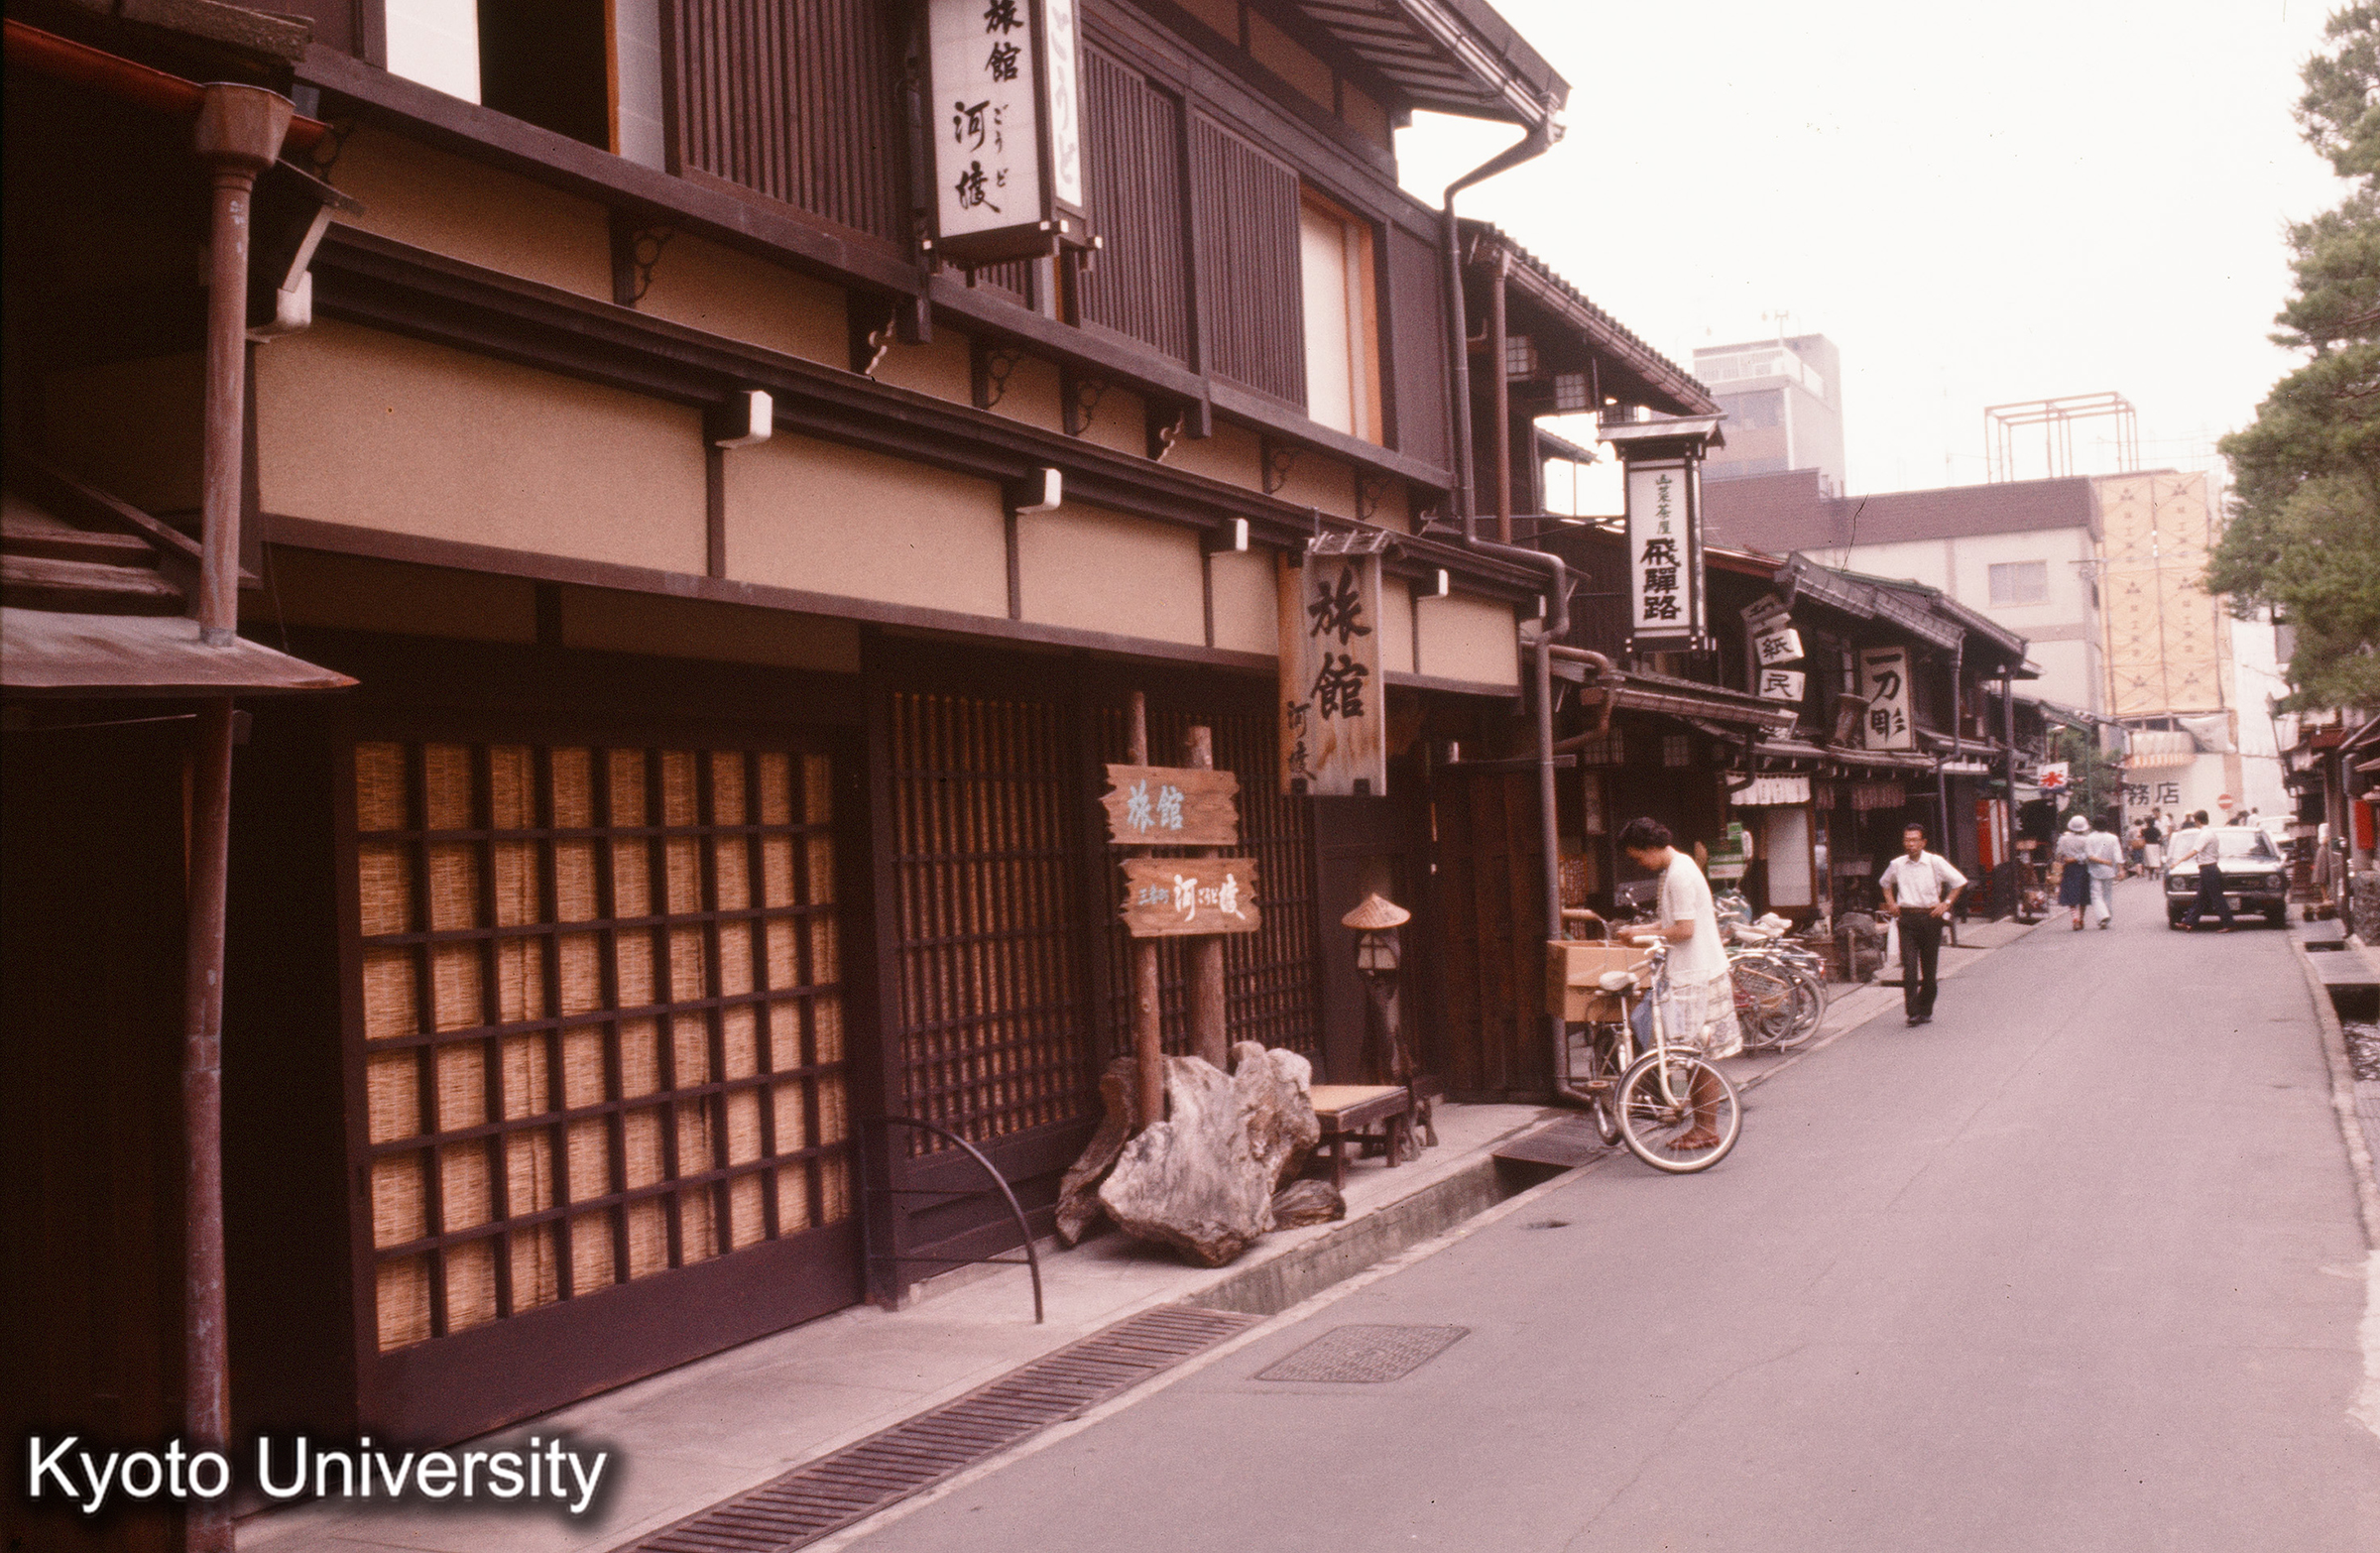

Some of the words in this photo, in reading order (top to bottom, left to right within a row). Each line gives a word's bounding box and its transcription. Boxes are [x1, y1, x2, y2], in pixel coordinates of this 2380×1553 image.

[984, 0, 1023, 82] 旅館
[993, 104, 1010, 188] ごうど
[1655, 473, 1674, 536] 山菜茶屋
[1307, 565, 1372, 722] 旅館
[1865, 653, 1907, 745] 一刀彫
[1127, 778, 1185, 835] 旅館
[2128, 781, 2181, 806] 務店
